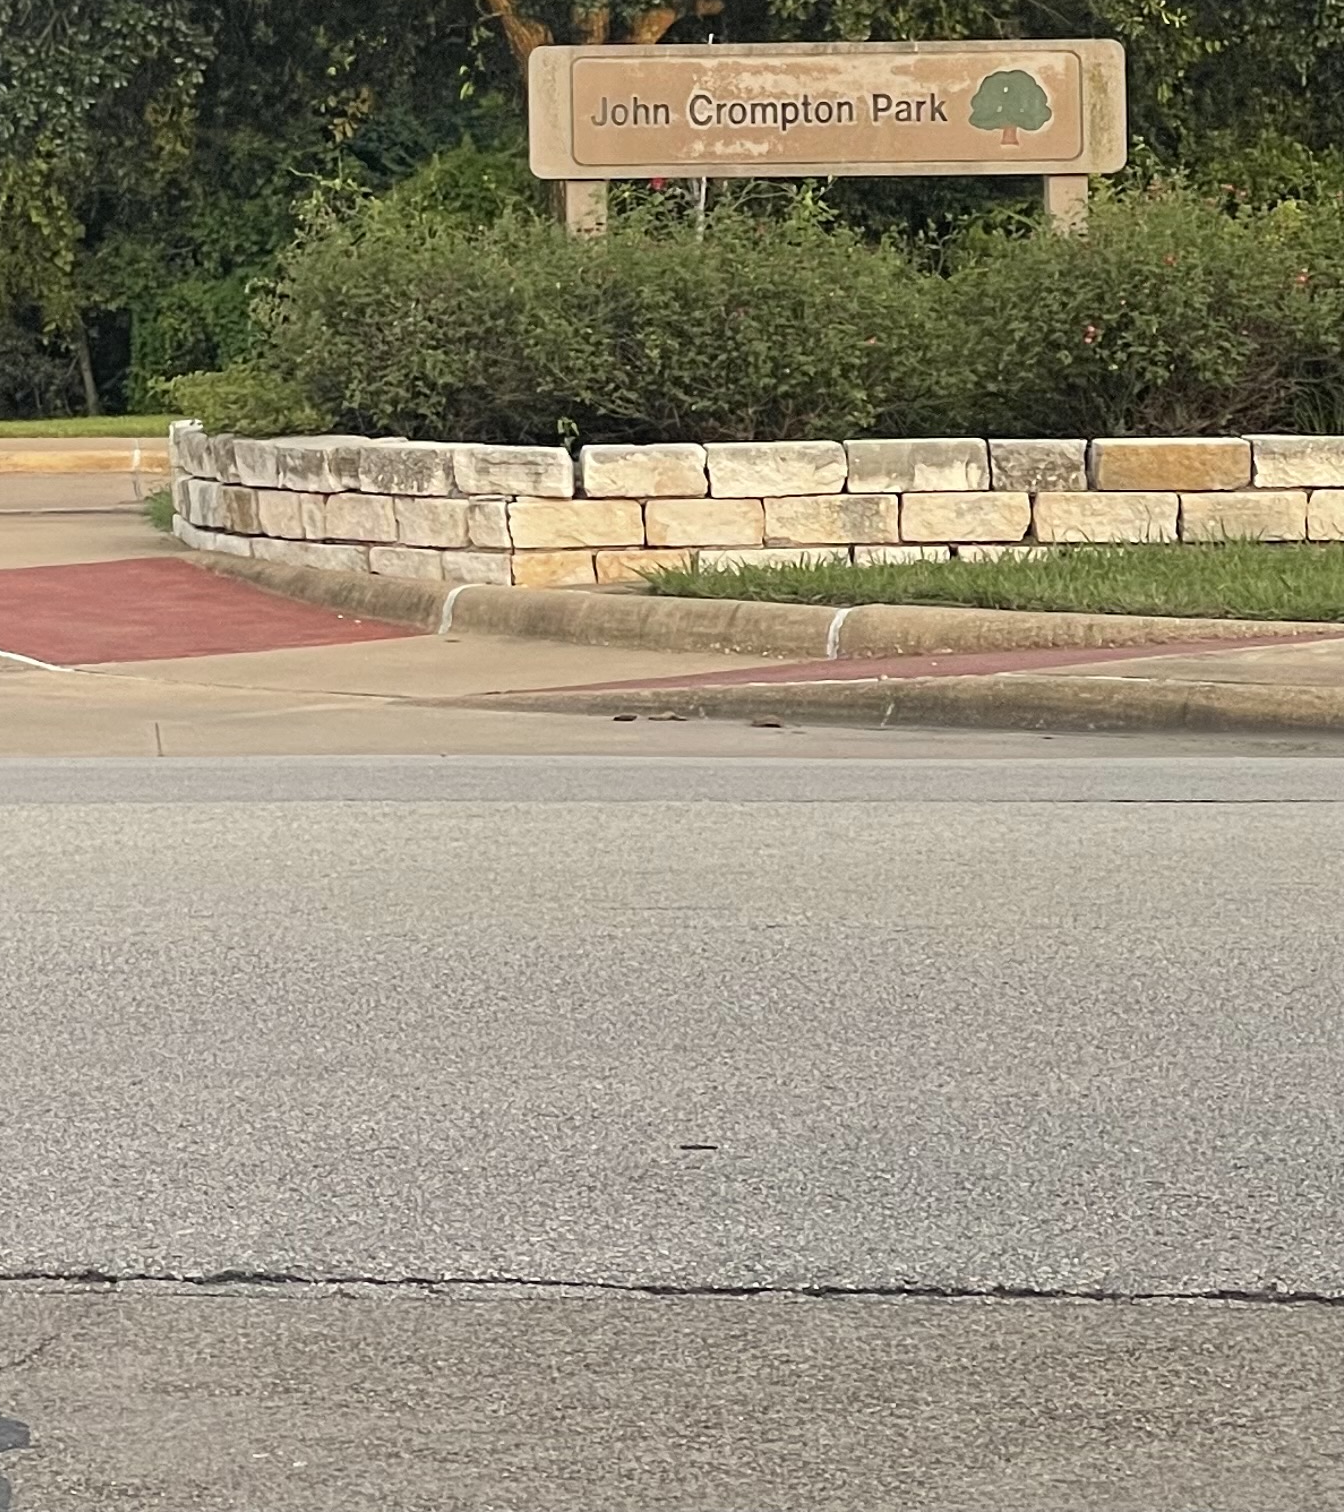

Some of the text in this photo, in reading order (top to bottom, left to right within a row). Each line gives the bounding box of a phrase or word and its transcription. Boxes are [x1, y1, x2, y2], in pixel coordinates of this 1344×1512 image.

[591, 92, 948, 131] John Crompton Park
